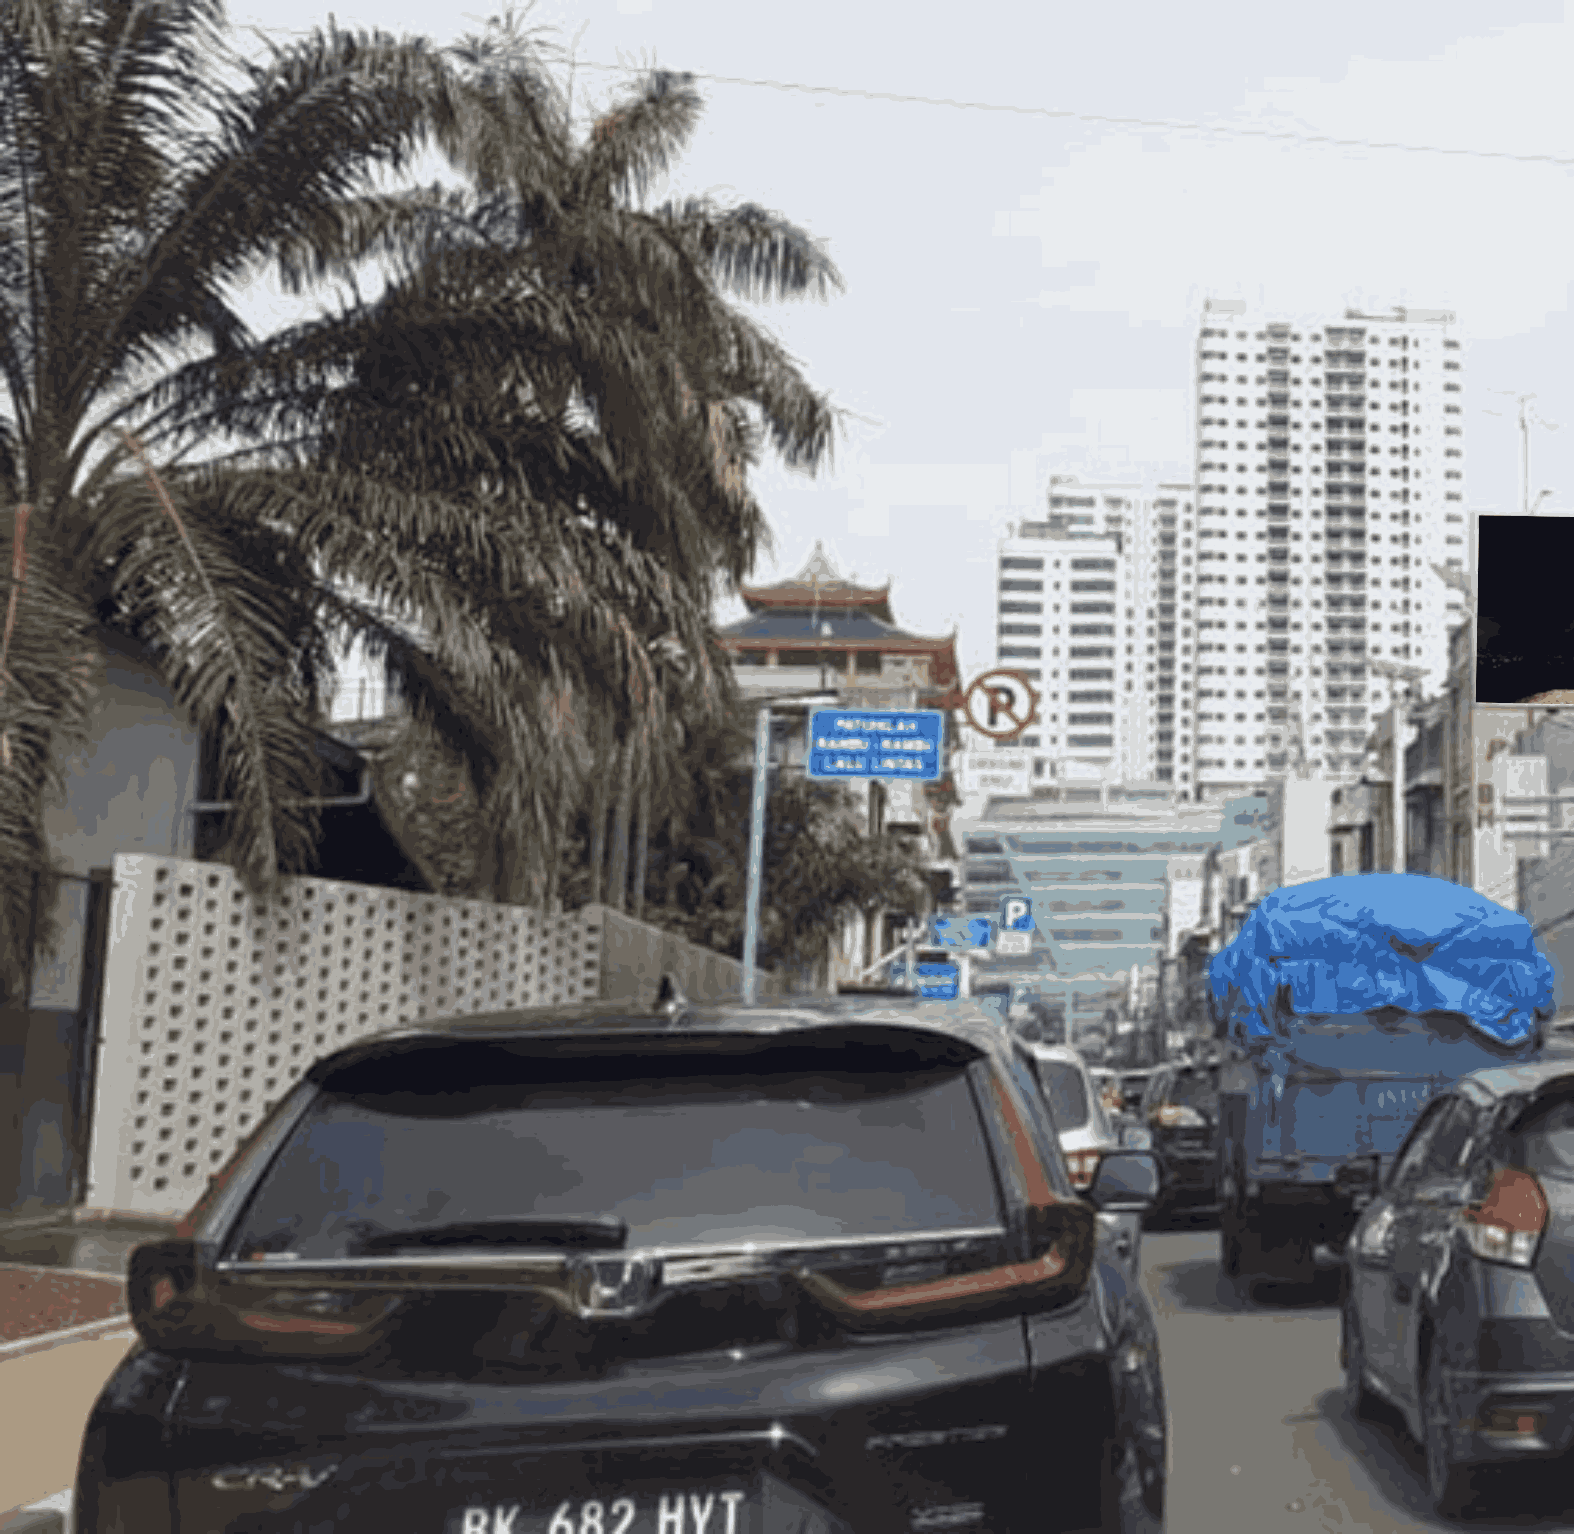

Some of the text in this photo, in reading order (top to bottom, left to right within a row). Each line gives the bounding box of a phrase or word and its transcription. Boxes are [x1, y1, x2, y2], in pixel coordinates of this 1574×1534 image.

[1006, 900, 1028, 926] P
[210, 1463, 339, 1492] CR-V
[461, 1488, 746, 1534] BK 682 HYT
